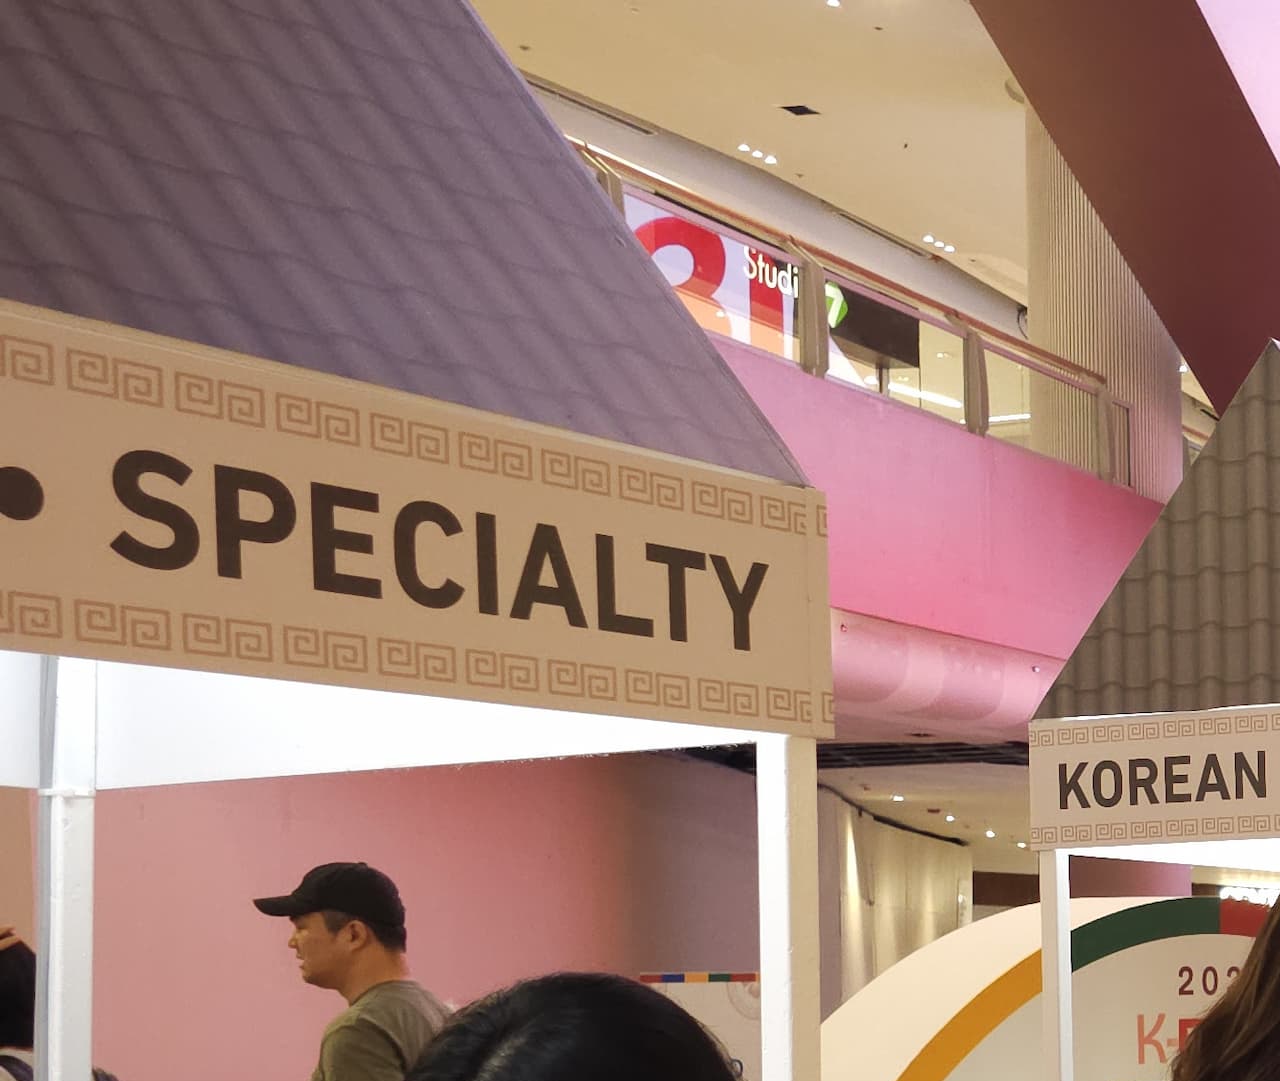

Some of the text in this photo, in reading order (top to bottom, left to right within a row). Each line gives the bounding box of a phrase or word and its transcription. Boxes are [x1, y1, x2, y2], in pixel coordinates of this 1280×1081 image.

[743, 245, 799, 298] Studi
[109, 449, 771, 652] SPECIALTY
[1058, 749, 1267, 811] KOREAN
[1178, 965, 1242, 996] 202
